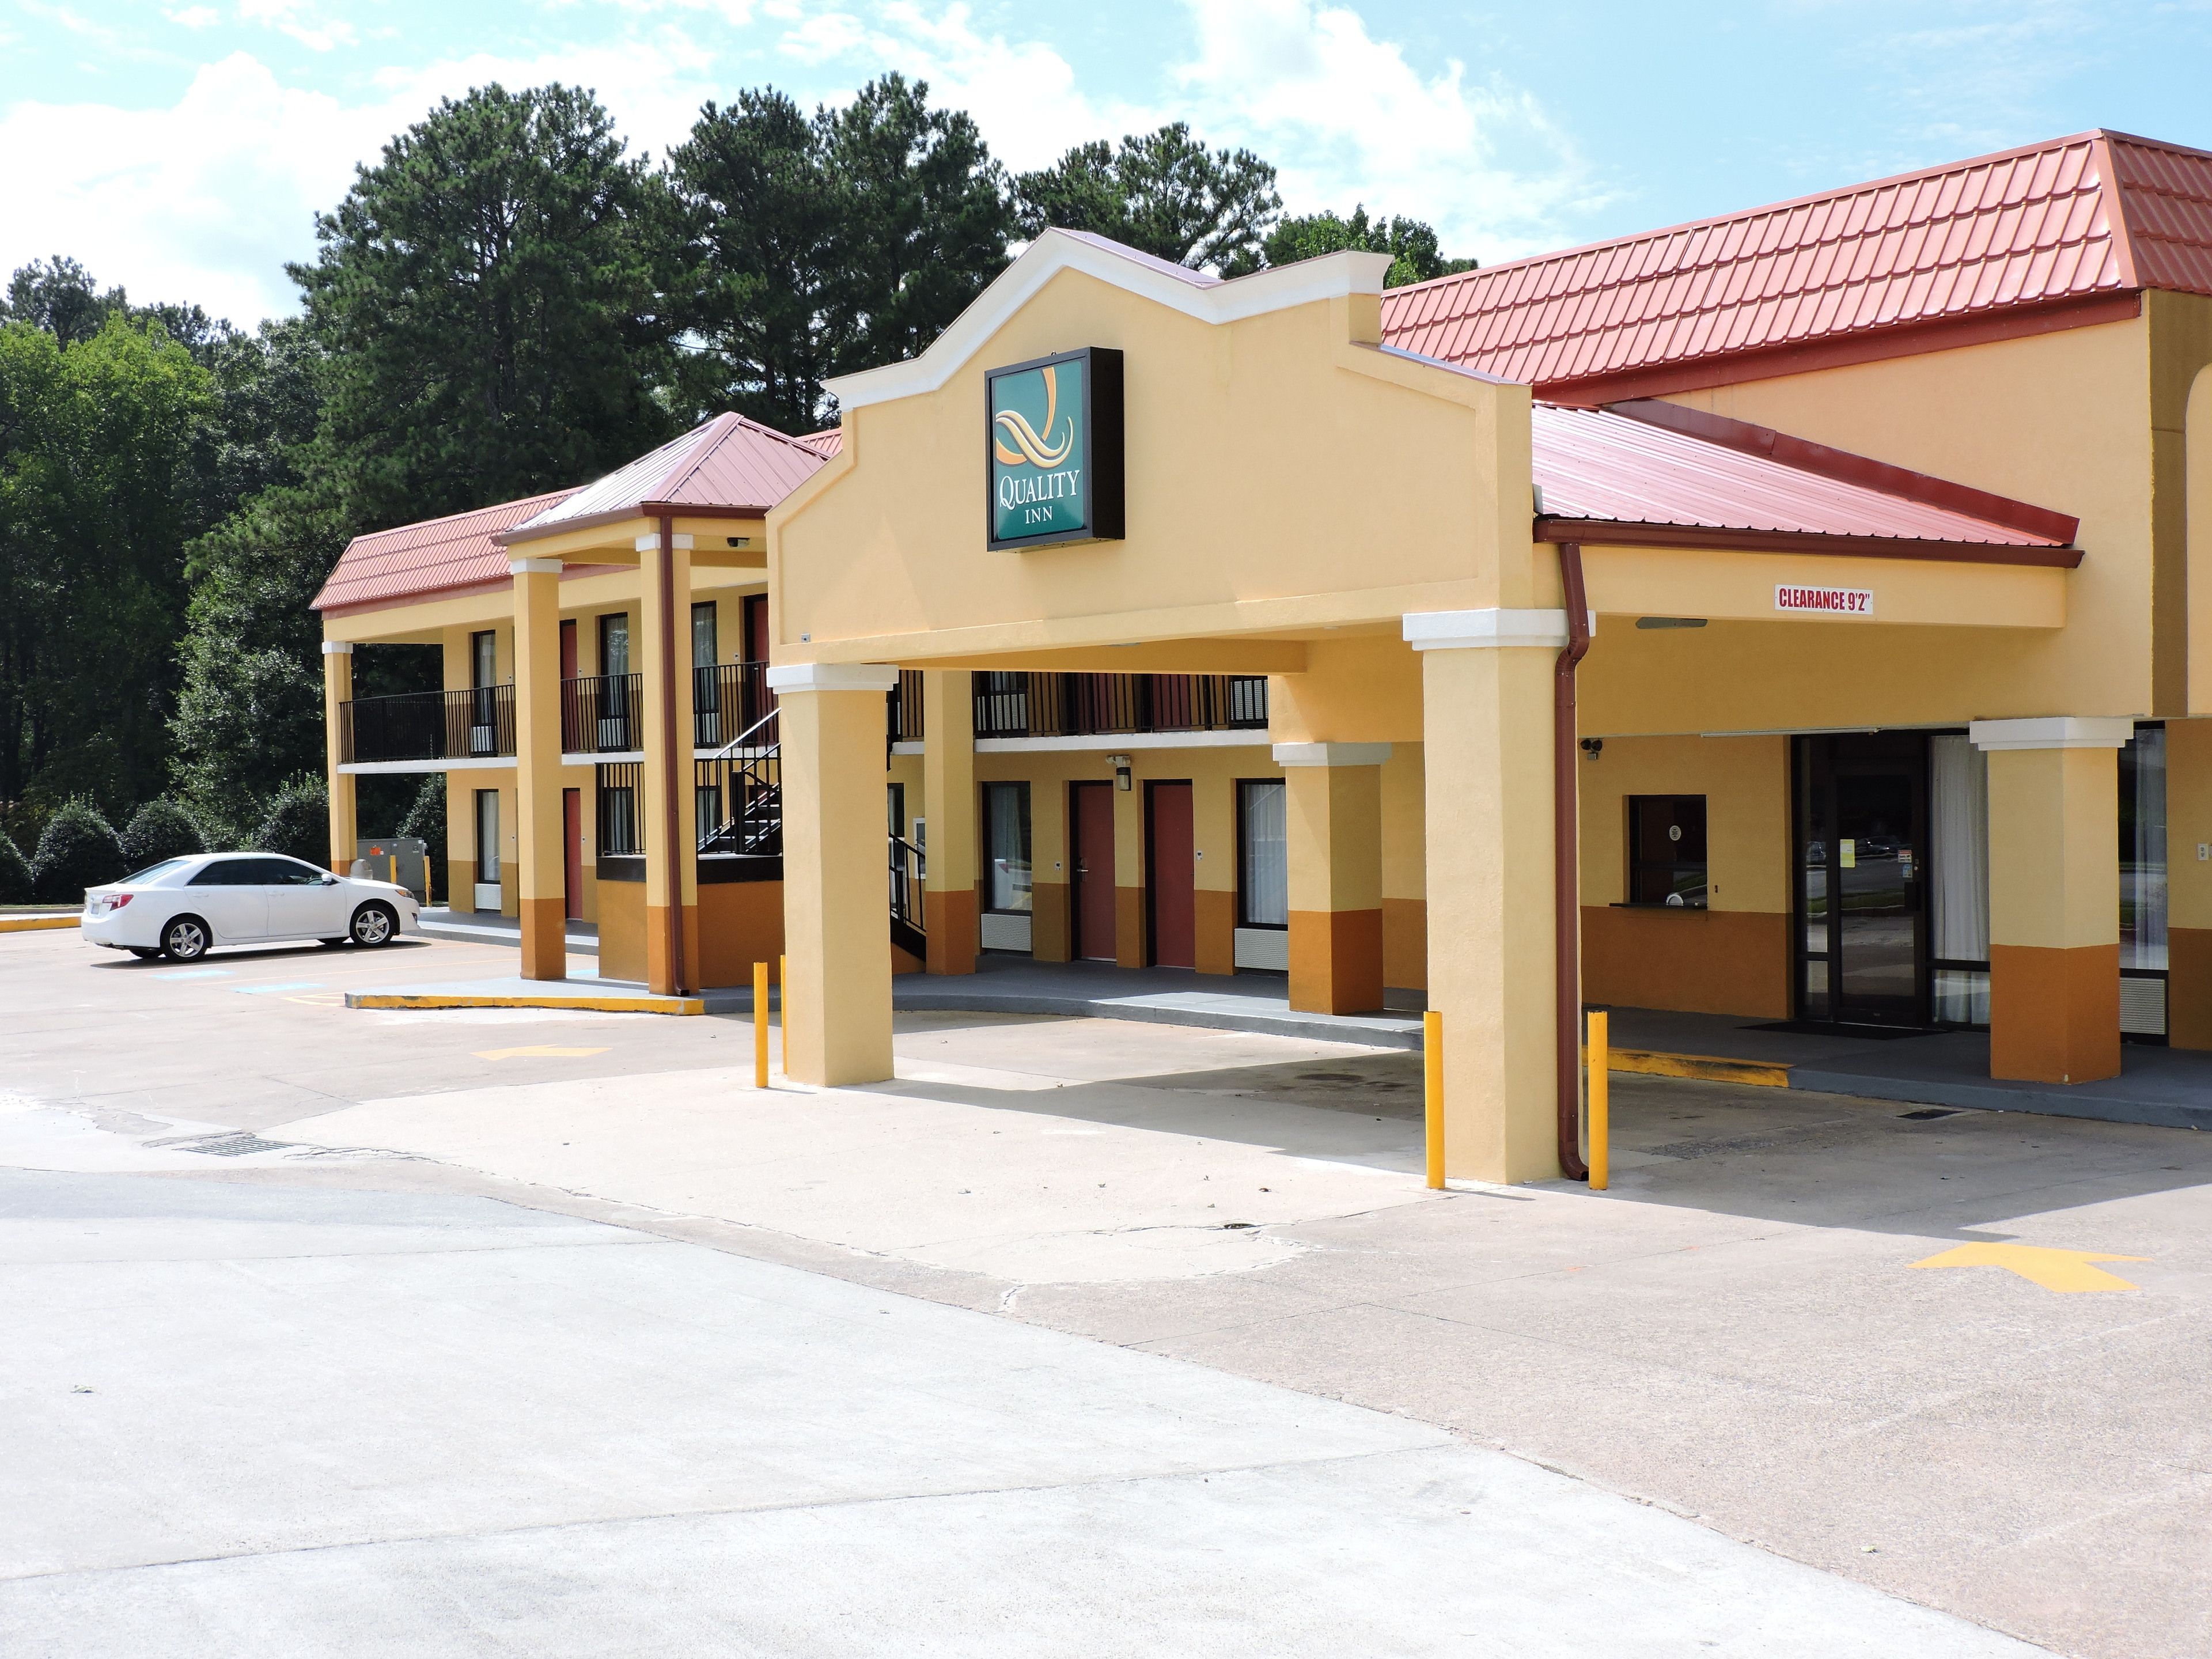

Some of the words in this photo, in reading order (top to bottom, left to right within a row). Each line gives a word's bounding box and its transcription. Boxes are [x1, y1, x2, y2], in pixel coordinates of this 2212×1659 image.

[999, 470, 1080, 510] QUALITY
[1025, 506, 1053, 524] INN
[1779, 588, 1845, 611] CLEARANCE
